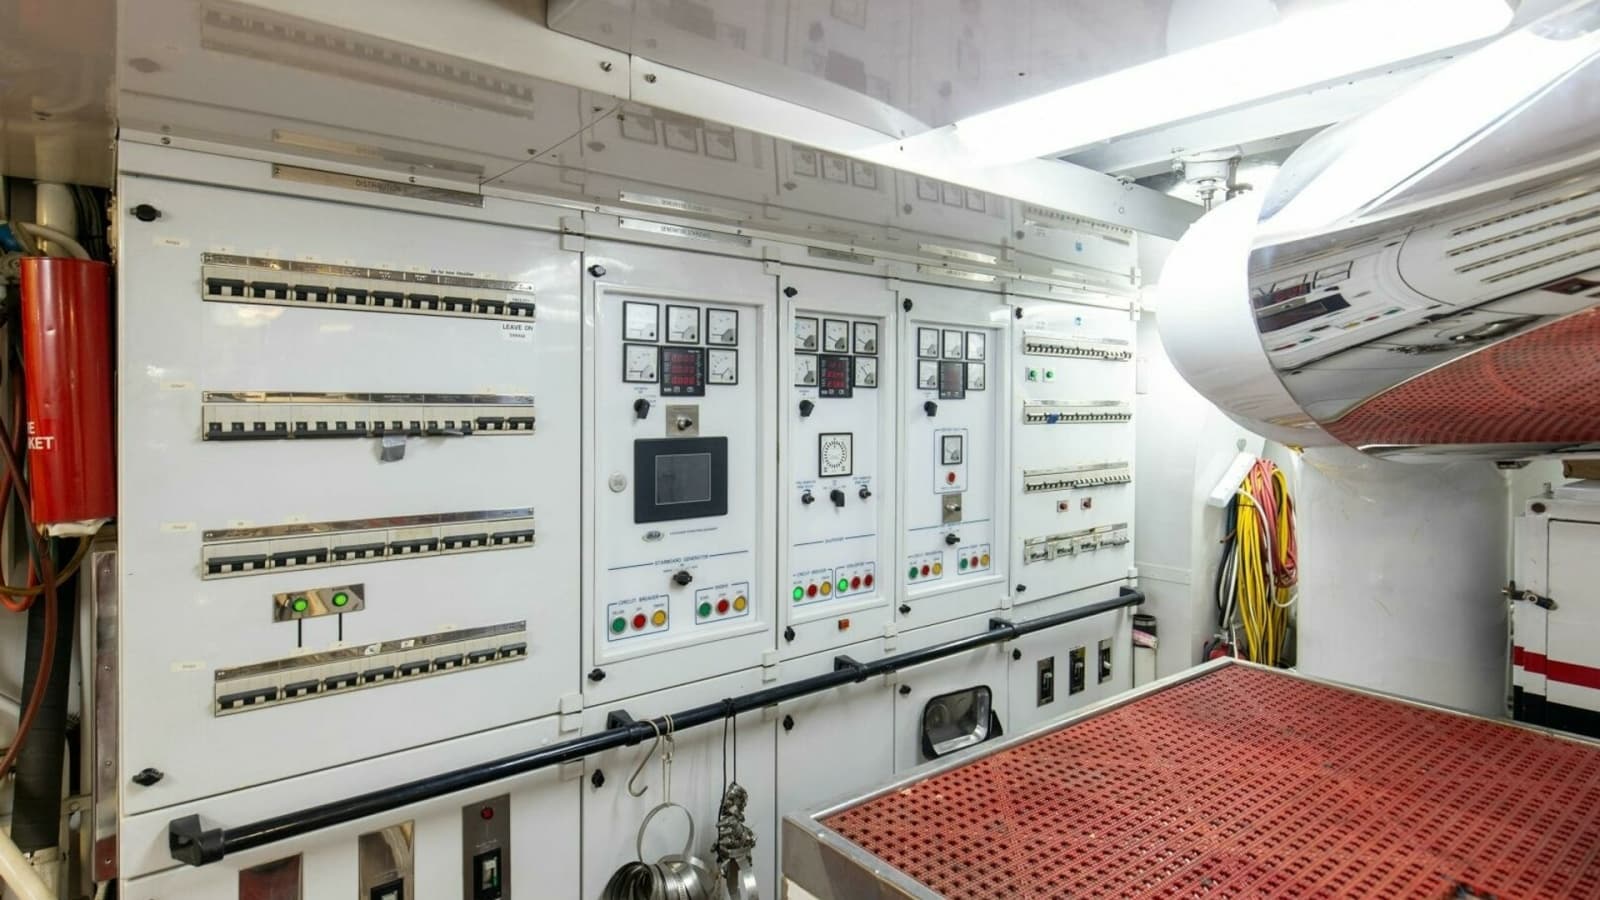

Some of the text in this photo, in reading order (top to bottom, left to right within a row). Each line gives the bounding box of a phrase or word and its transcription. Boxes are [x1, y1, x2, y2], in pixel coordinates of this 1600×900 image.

[502, 323, 522, 331] LEAVE
[27, 421, 35, 434] E
[618, 594, 659, 606] CIRCUIT BREAKER
